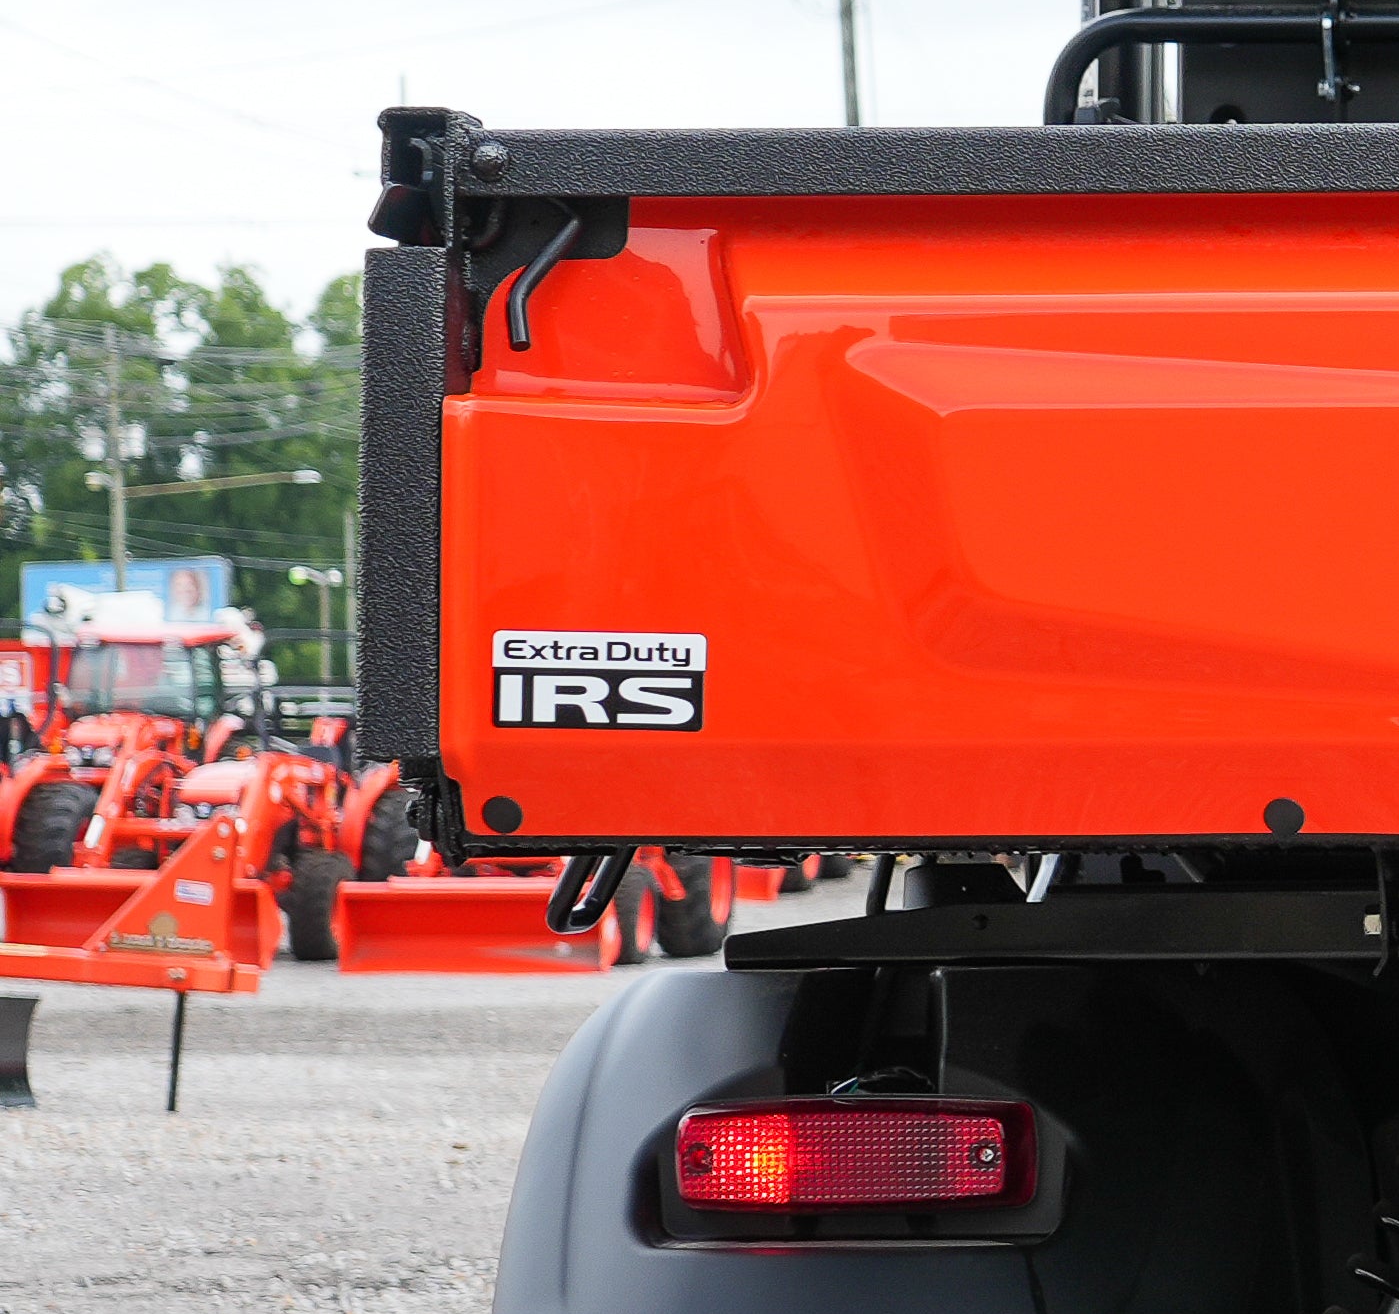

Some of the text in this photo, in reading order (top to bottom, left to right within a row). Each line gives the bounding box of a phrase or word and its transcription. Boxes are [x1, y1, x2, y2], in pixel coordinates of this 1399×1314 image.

[504, 639, 691, 667] Extra Duty
[498, 674, 695, 725] IRS
